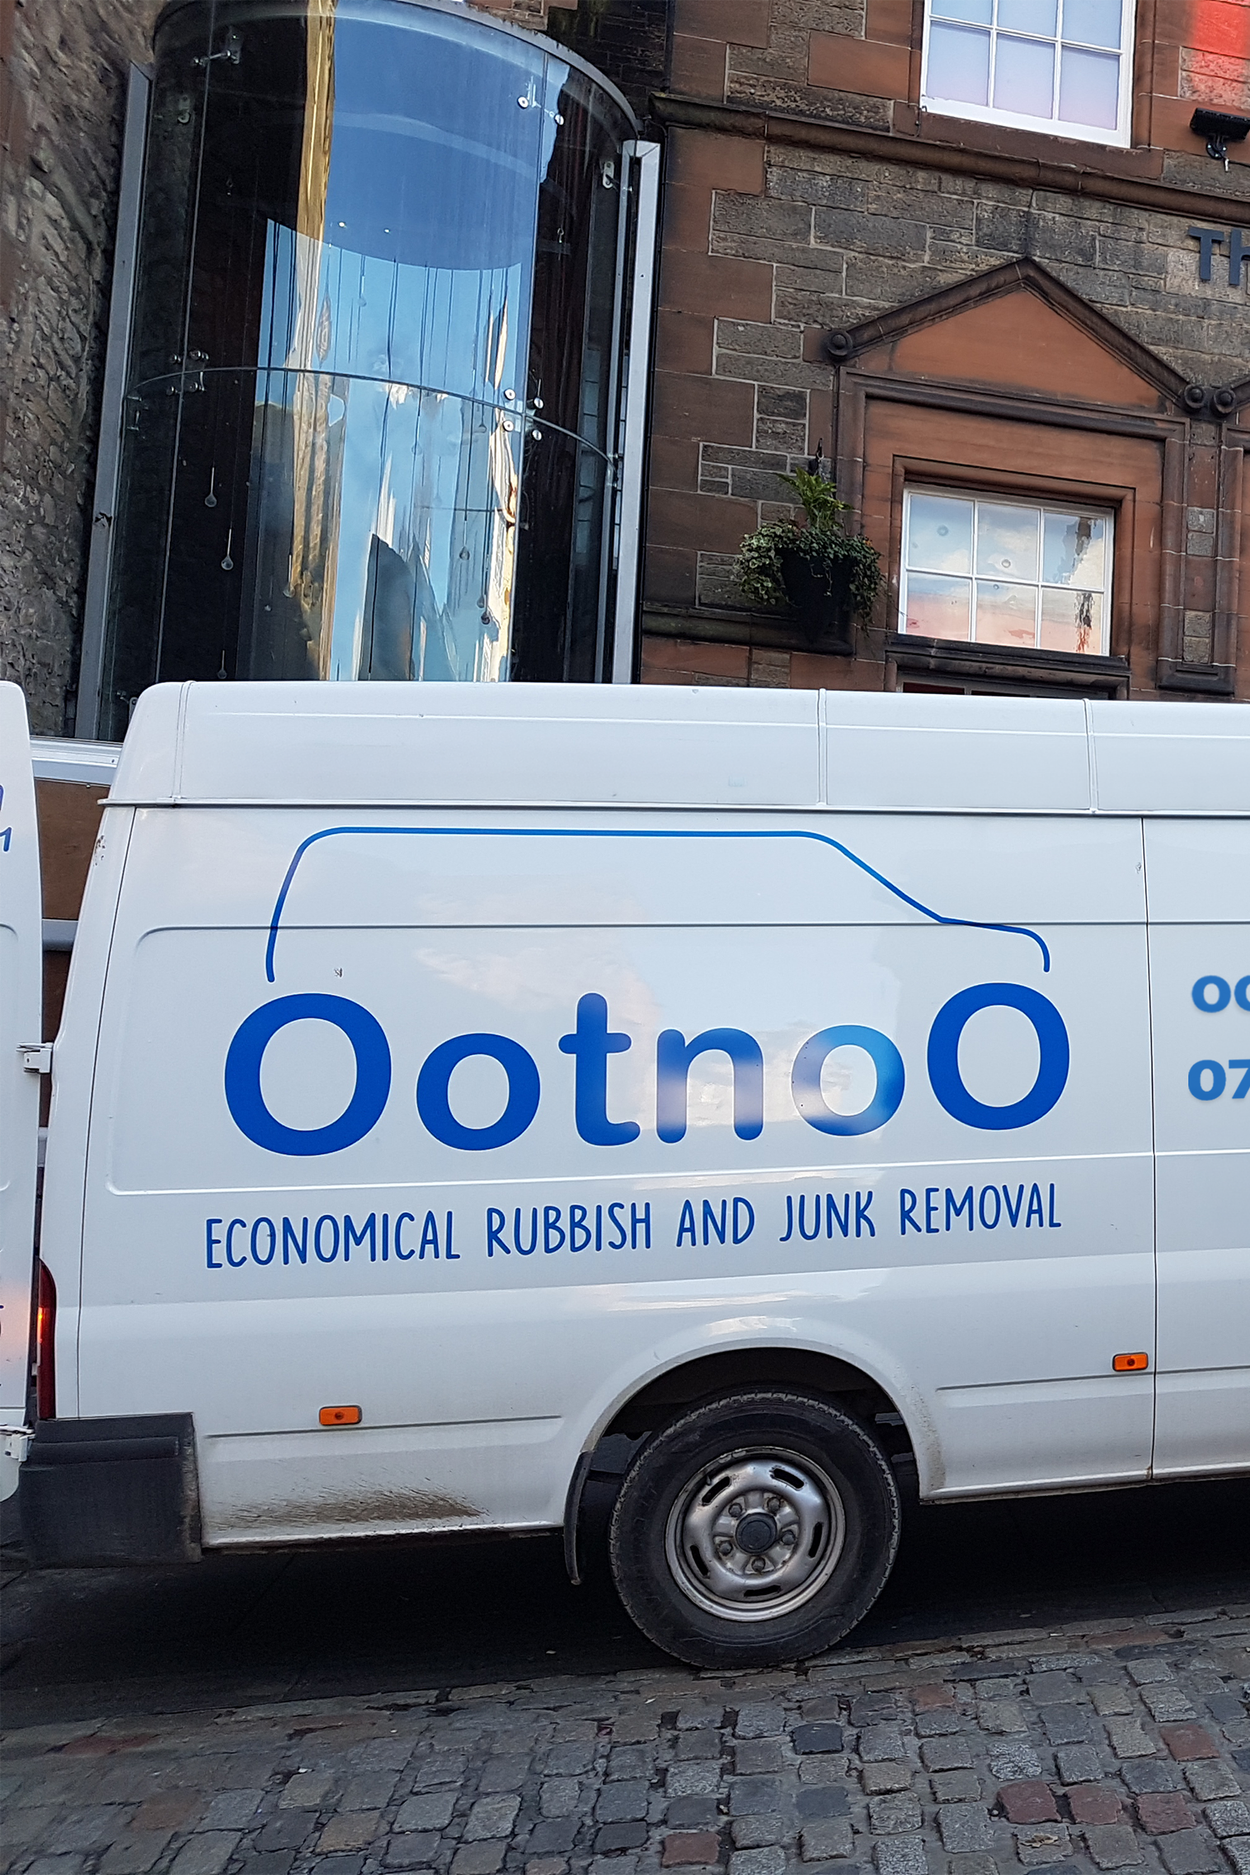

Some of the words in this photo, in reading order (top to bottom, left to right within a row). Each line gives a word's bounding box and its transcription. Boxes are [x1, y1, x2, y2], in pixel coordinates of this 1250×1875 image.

[225, 982, 1070, 1157] OotnoO
[206, 1211, 460, 1269] ECONOMICAL
[486, 1202, 651, 1258] RUBBISH
[676, 1197, 755, 1247] AND
[780, 1192, 875, 1242] JUNK
[900, 1184, 1062, 1235] REMOVAL
